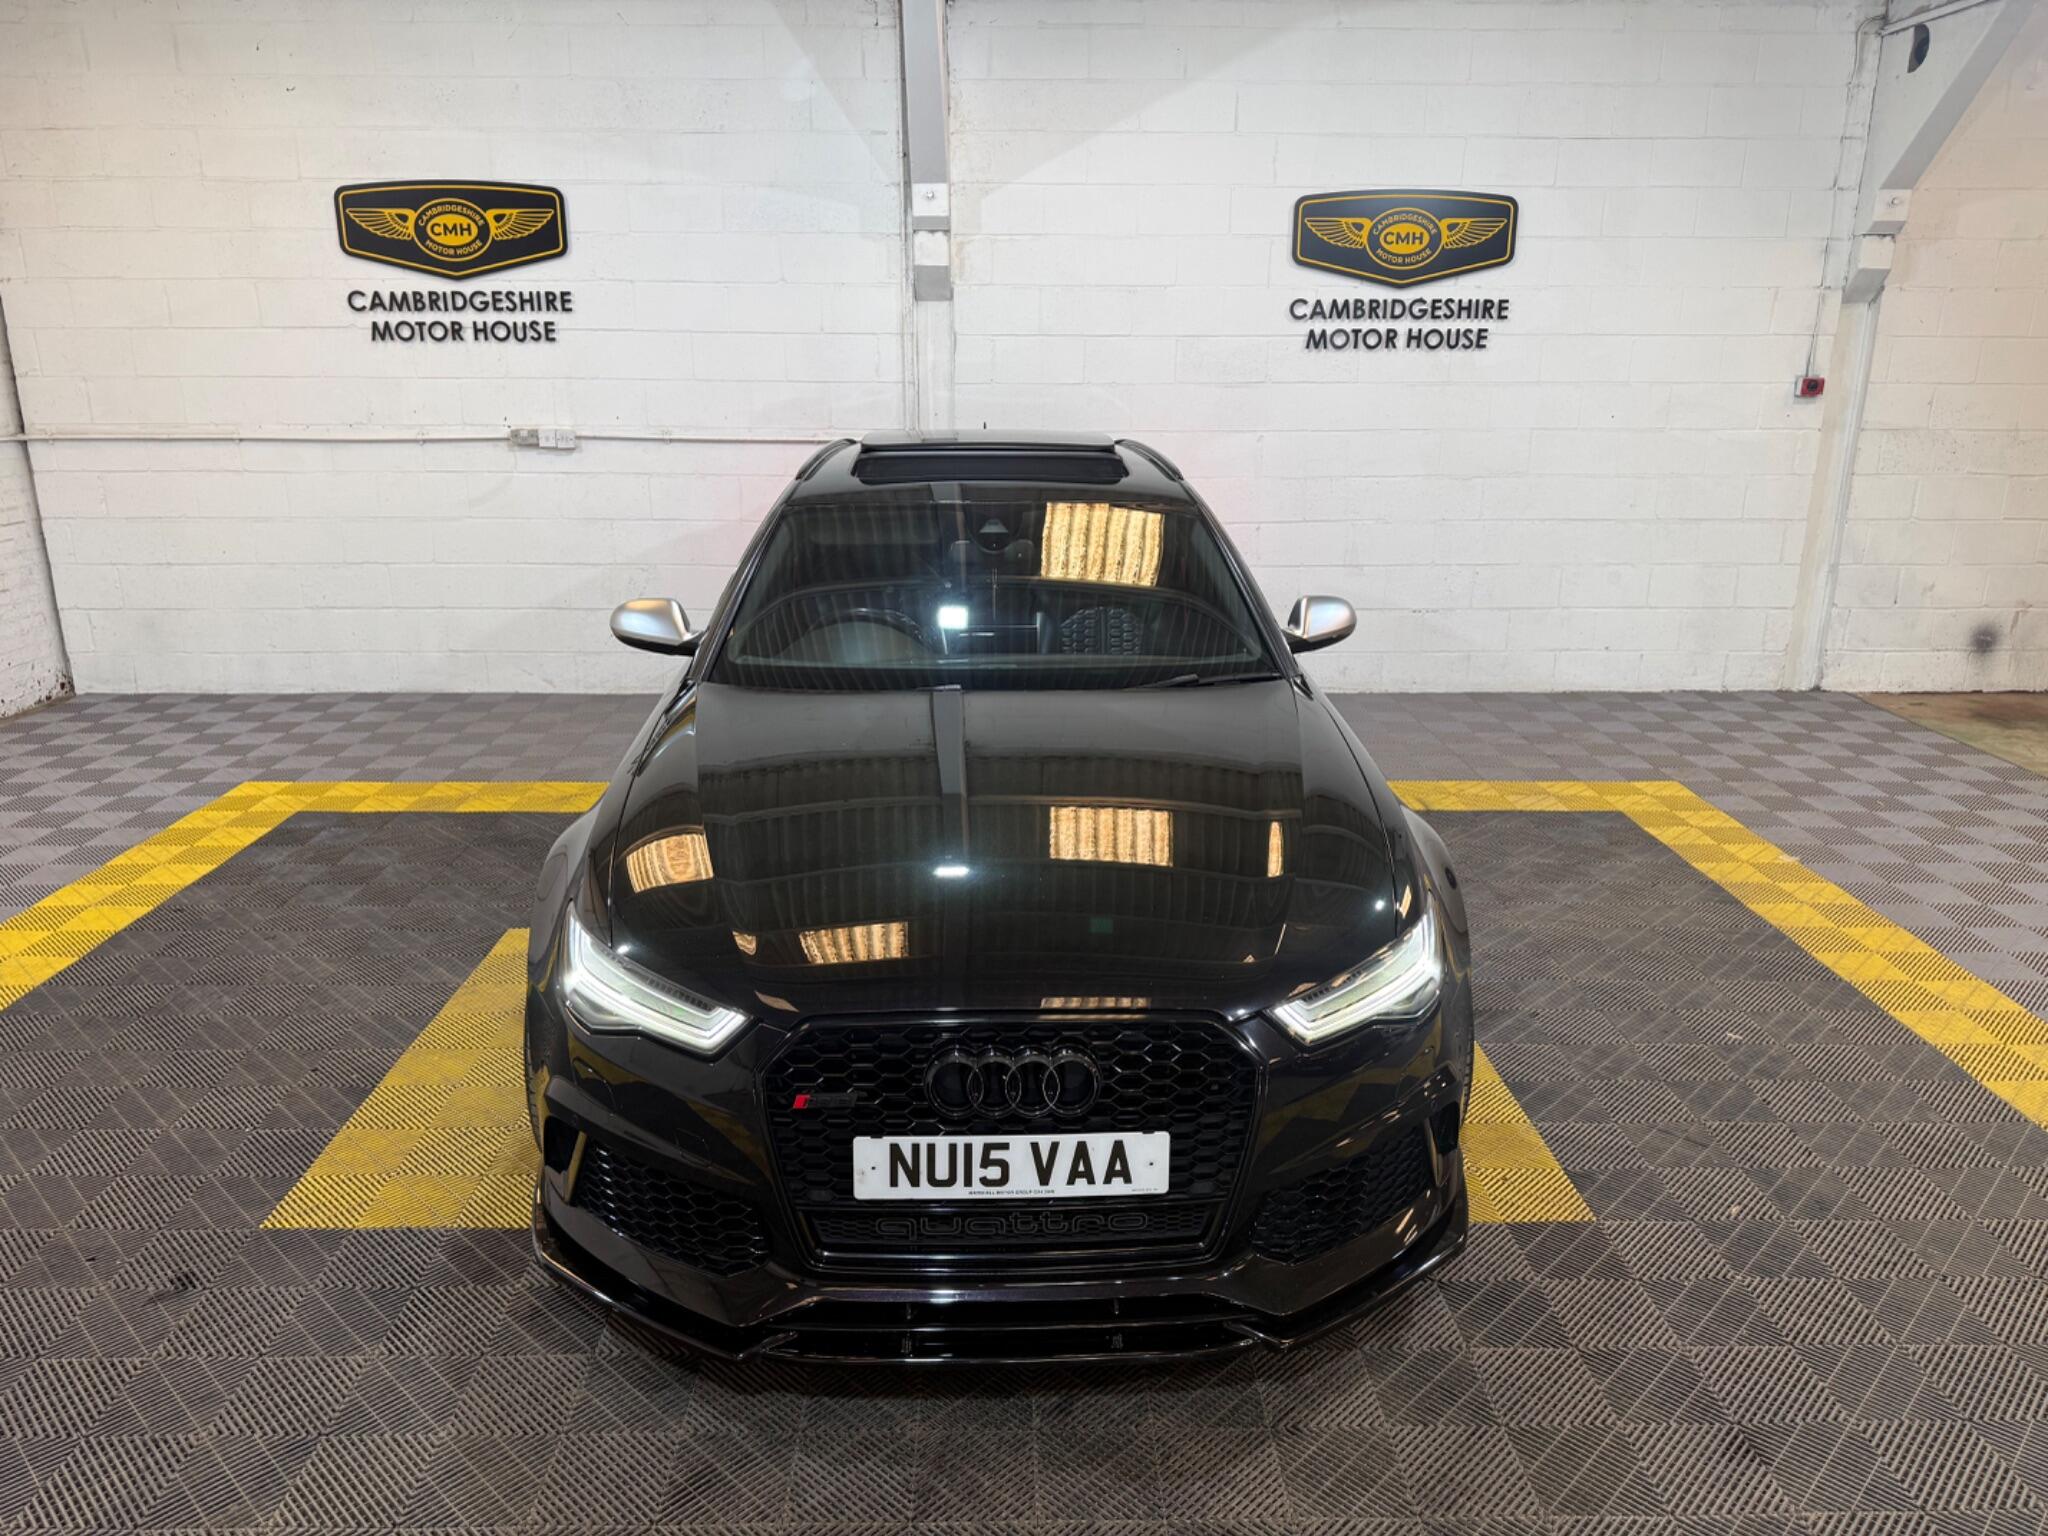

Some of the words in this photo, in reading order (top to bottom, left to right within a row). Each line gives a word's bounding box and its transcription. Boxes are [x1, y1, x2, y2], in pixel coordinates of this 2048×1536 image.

[418, 204, 485, 226] CAMBRIDGESHIRE
[1374, 213, 1437, 234] CAMBRIDGESHIRE
[430, 222, 472, 236] CMH
[1383, 231, 1424, 245] CMH
[425, 240, 455, 255] MOTOR
[456, 240, 482, 255] HOUSE
[1376, 248, 1403, 263] MOTOR
[1405, 248, 1432, 263] HOUSE
[348, 290, 573, 312] CAMBRIDGESHIRE
[1289, 297, 1509, 320] CAMBRIDGESHIRE
[371, 320, 464, 342] MOTOR
[473, 320, 556, 342] HOUSE
[1305, 328, 1398, 350] MOTOR
[1406, 328, 1489, 350] HOUSE
[889, 1142, 1010, 1188] NU15
[1031, 1140, 1133, 1187] VAA
[875, 1211, 1148, 1241] quattro
